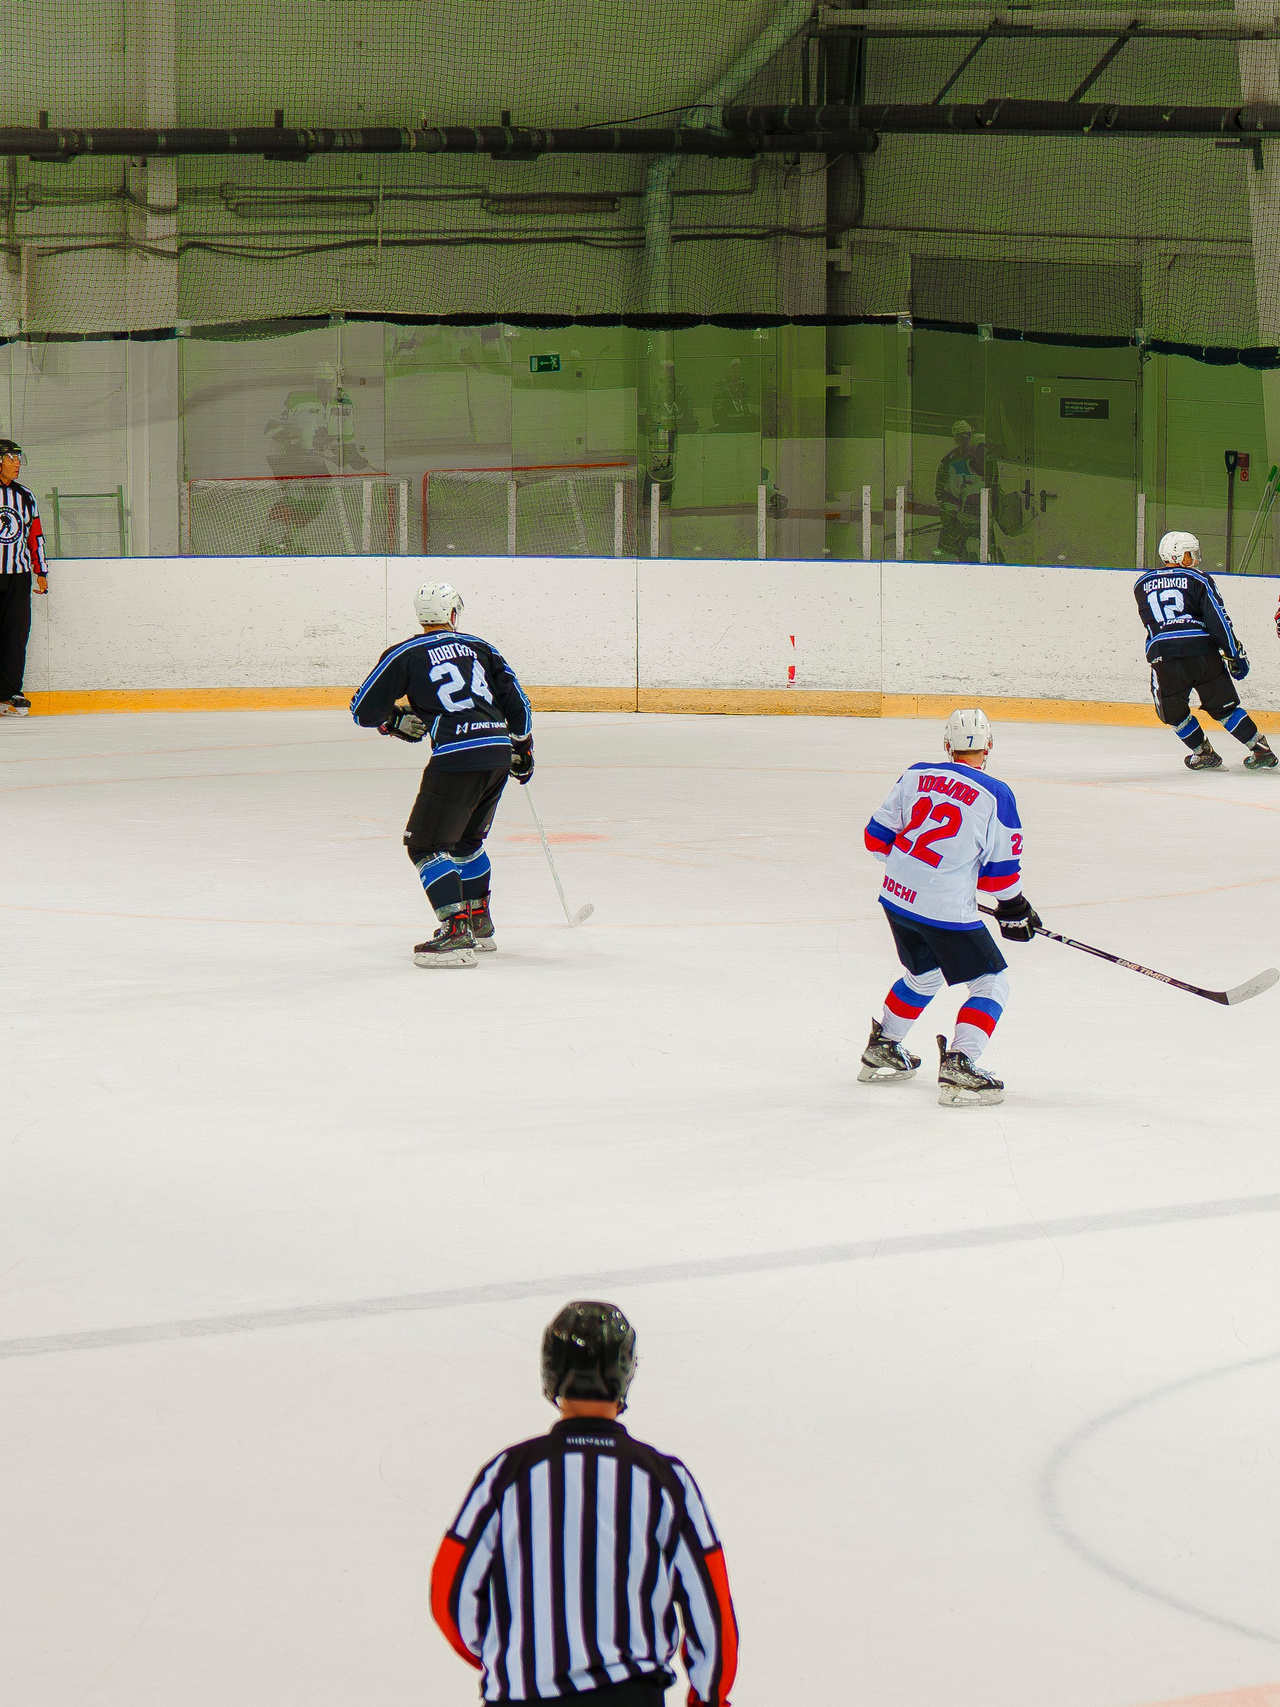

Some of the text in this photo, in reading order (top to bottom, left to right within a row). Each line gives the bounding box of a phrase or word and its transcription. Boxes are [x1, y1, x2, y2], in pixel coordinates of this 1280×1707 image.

[1147, 588, 1193, 623] 12
[428, 661, 494, 713] 24
[966, 735, 974, 748] 7
[893, 795, 963, 869] 22
